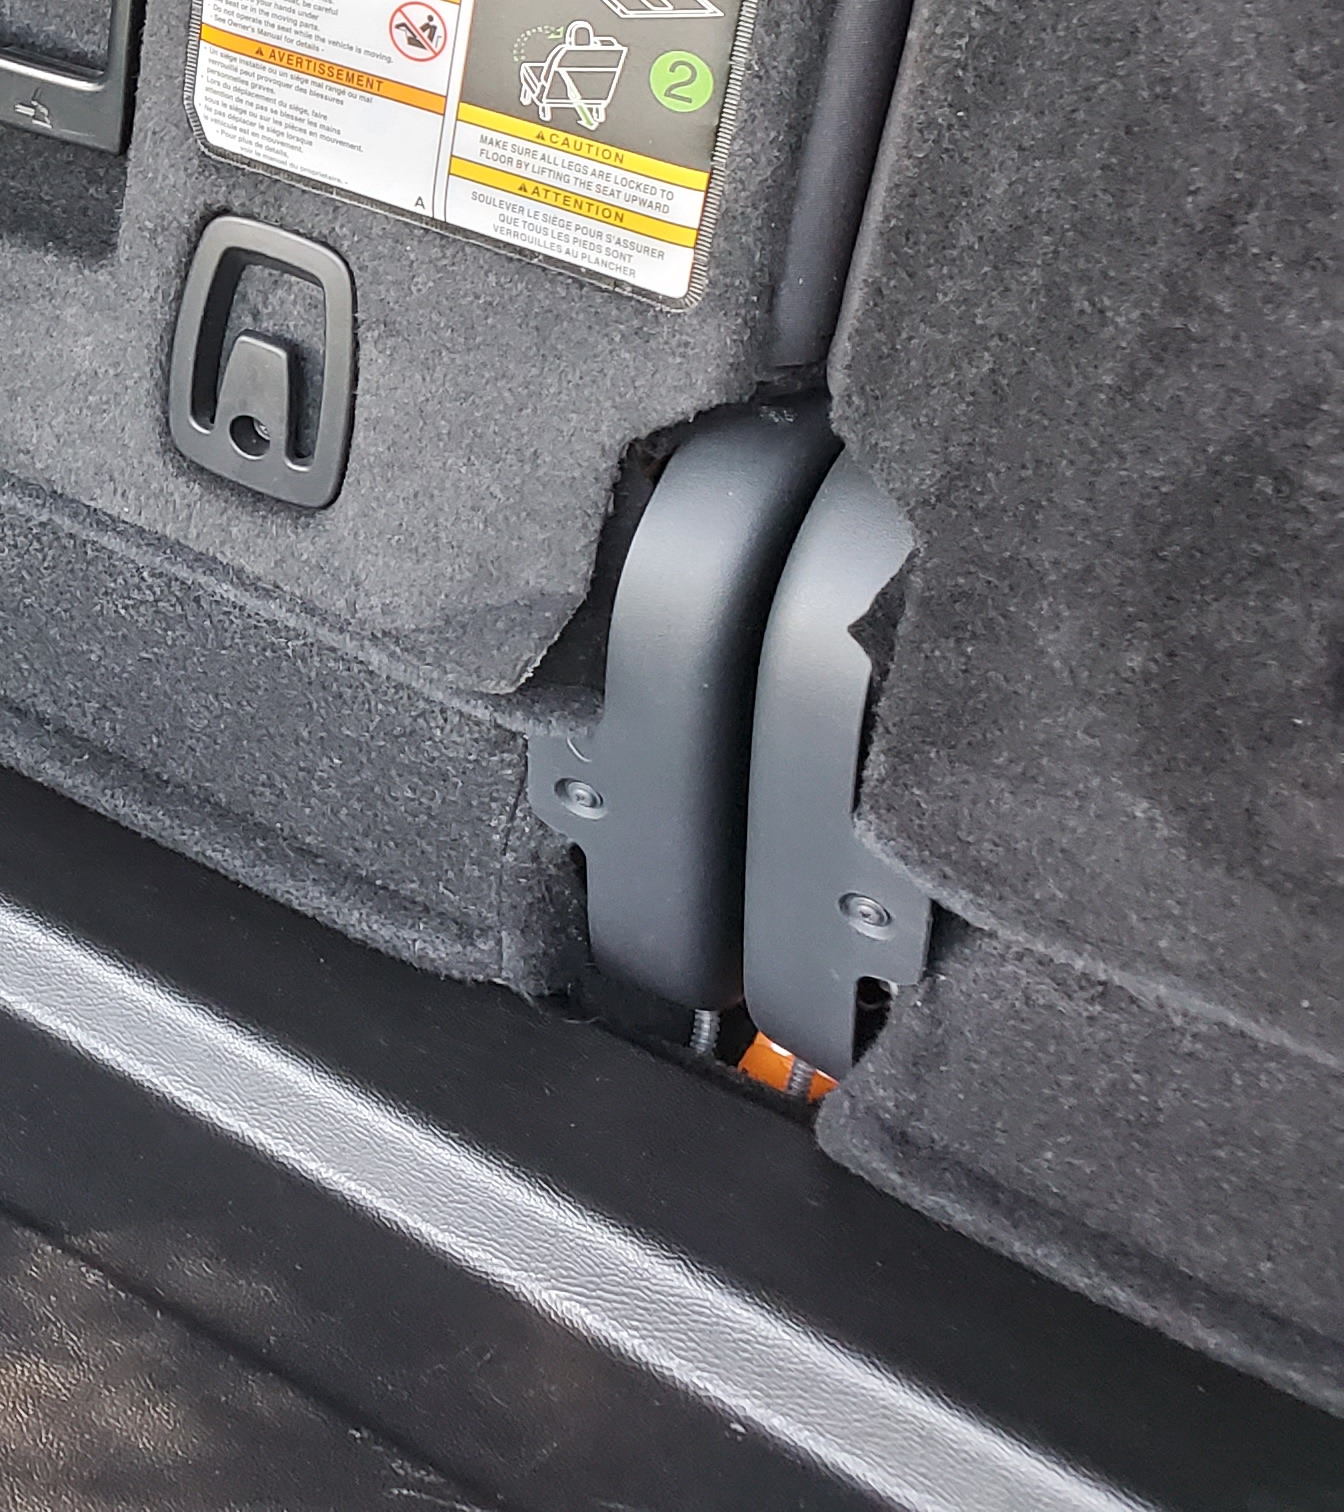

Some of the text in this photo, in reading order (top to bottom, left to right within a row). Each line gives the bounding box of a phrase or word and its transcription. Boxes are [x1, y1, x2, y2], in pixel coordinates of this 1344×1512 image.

[268, 48, 384, 91] AVERTISSEMENT
[478, 133, 674, 201] MAKE SURE ALL LEGS ARE LOCKED TO
[549, 132, 624, 164] CAUTION
[413, 195, 425, 209] A
[478, 147, 669, 214] FLOOR BY LIFTING THE SEAT UPWARD
[470, 190, 525, 215] SOULEVER
[526, 208, 540, 220] LE
[573, 223, 603, 240] POUR
[604, 233, 665, 260] S'ASSURER
[530, 185, 624, 223] ATTENTION
[498, 212, 633, 263] QUE TOUS LES PIEDS SONT
[563, 247, 578, 258] AU
[580, 251, 636, 278] PLANCHER
